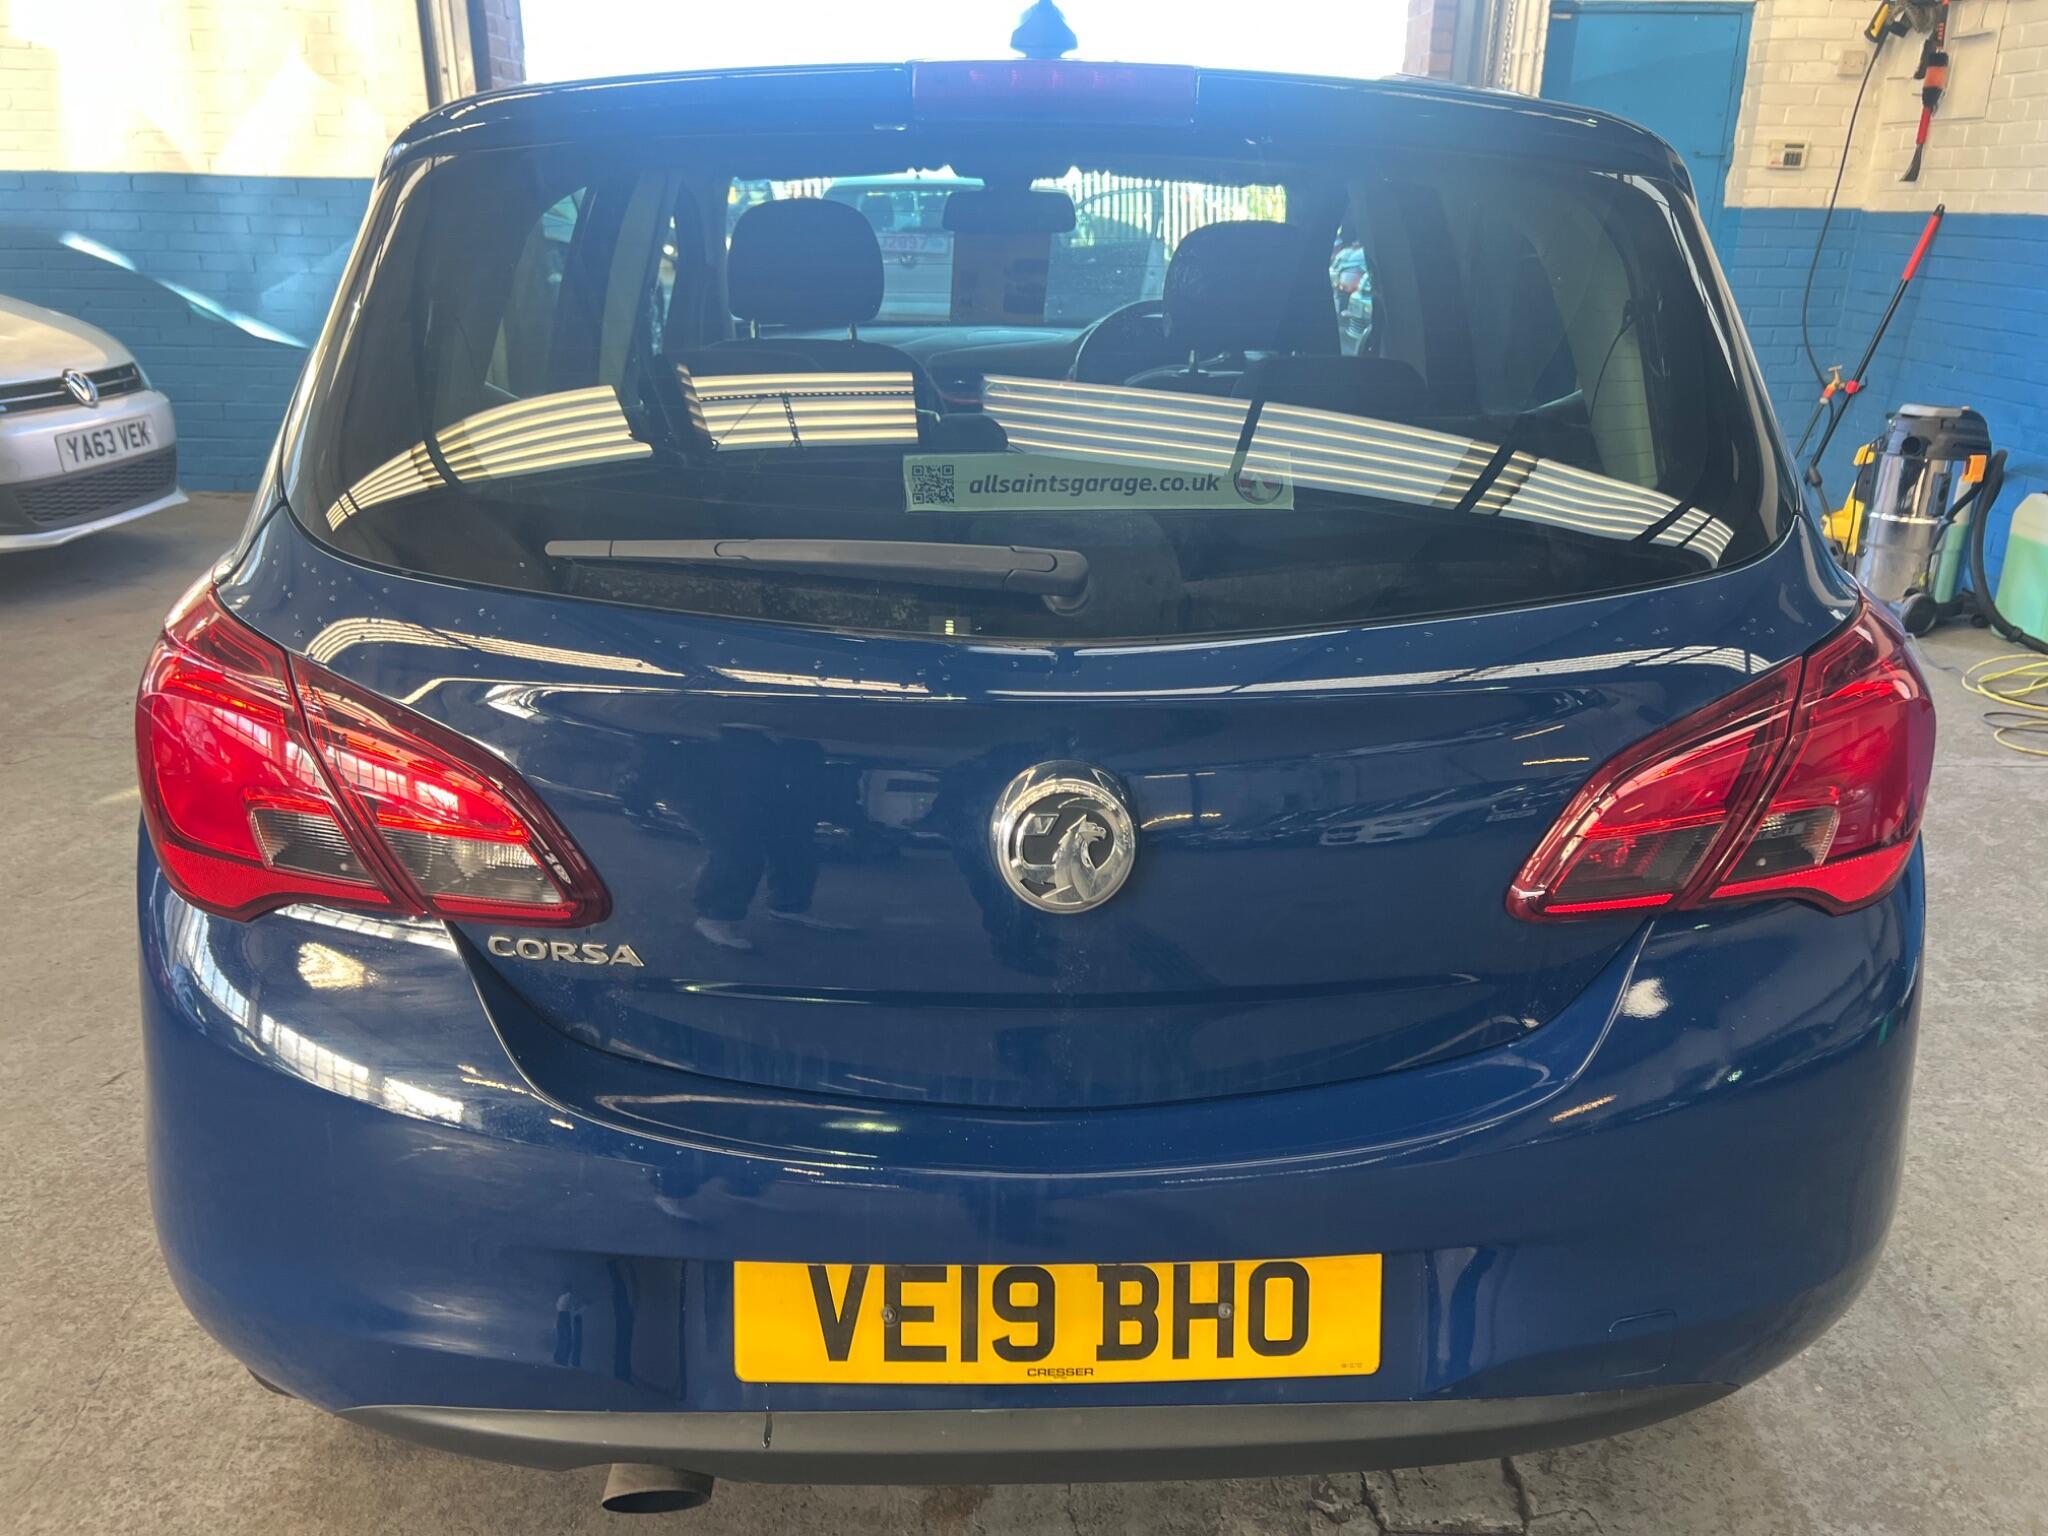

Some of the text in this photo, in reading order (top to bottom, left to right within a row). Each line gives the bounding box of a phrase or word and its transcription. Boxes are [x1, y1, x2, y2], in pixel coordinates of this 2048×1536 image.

[66, 420, 151, 463] YA63 VEK
[969, 473, 1220, 497] allsaintsgarage.co.uk
[488, 935, 645, 967] CORSA
[808, 1260, 1310, 1363] VE19 BHO
[1027, 1367, 1094, 1377] CRESSER
